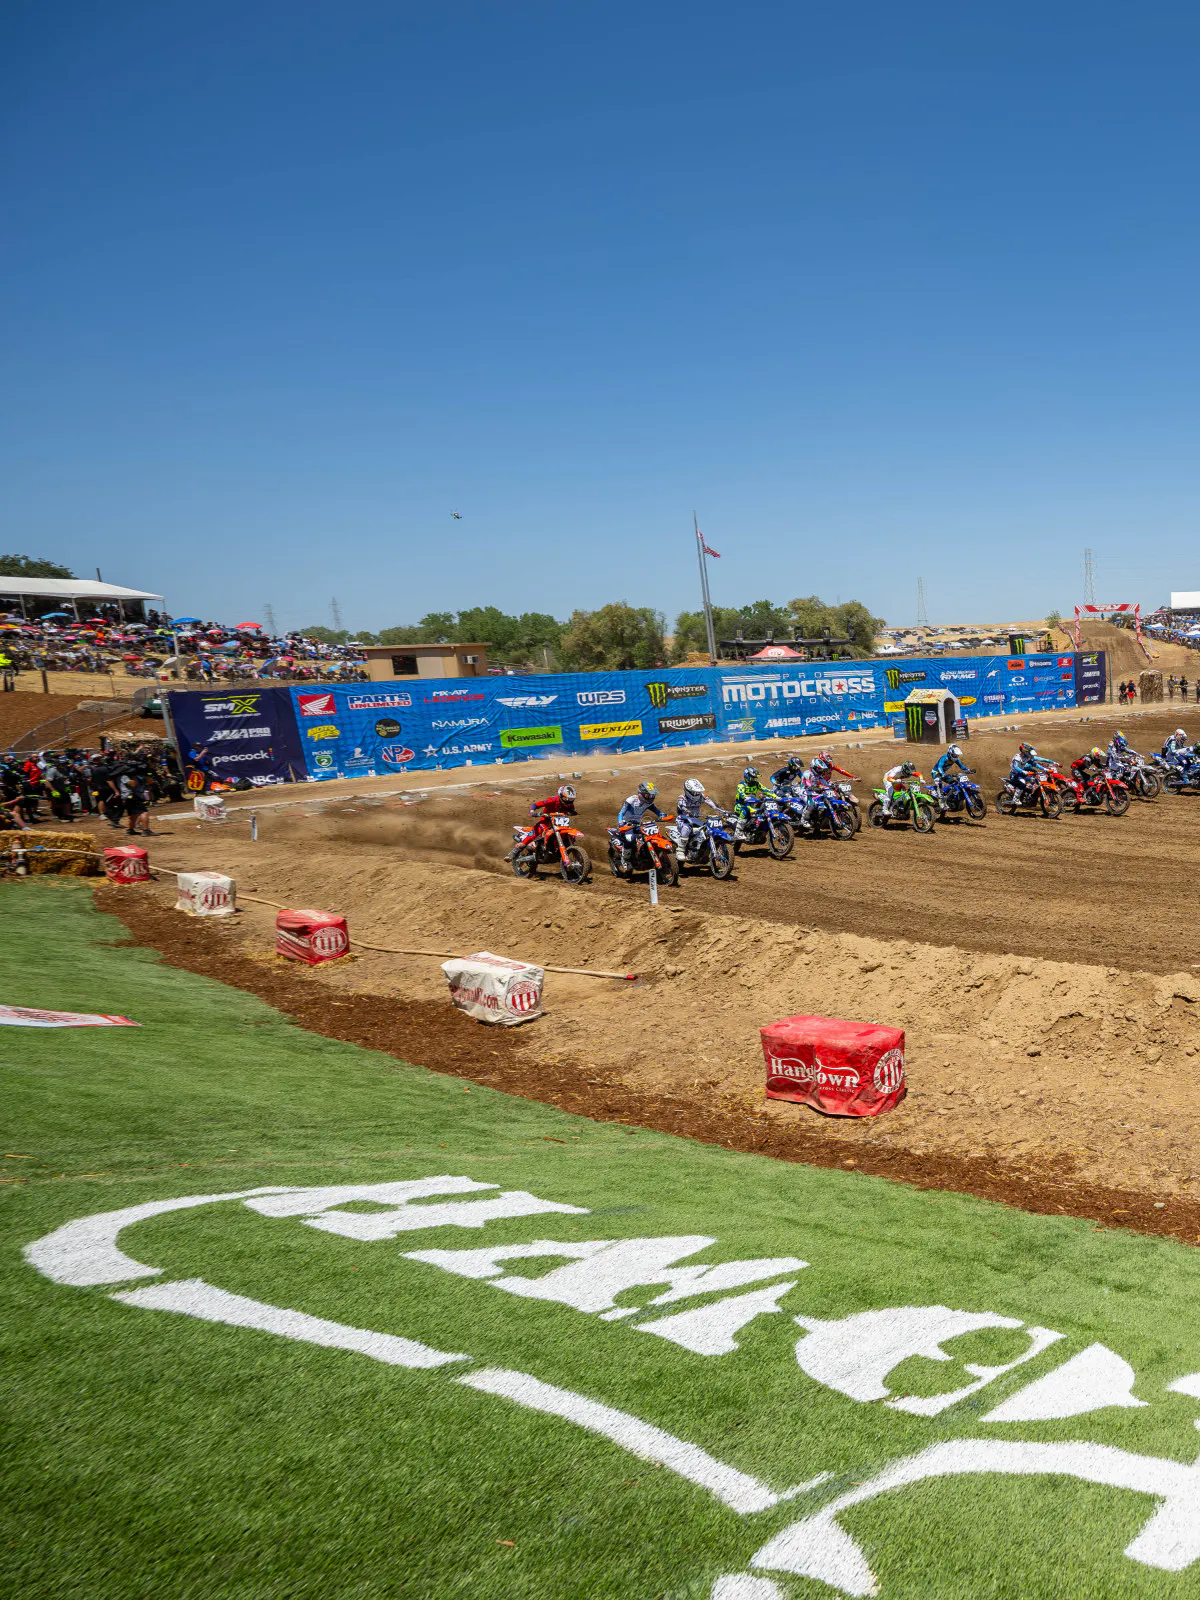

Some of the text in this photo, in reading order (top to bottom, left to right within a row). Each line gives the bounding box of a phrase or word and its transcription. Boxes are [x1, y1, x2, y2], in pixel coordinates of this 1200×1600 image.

[782, 671, 822, 679] PRO
[667, 685, 706, 694] MONSTER
[721, 676, 876, 703] MOTOCROSS
[348, 692, 411, 703] PARTS
[578, 691, 625, 705] WPS
[724, 694, 877, 711] CHAMPIONSHIP
[203, 698, 258, 715] SMX
[349, 700, 412, 709] UNLIMITED
[806, 713, 842, 727] peacock
[861, 710, 879, 720] NBC
[432, 717, 490, 729] NAMURA
[592, 723, 640, 734] DUNLOP
[660, 717, 703, 730] TRIUMPH
[507, 732, 556, 743] Kawasaki
[381, 744, 404, 763] VP
[442, 743, 493, 755] U.S. ARMY
[212, 750, 271, 767] peacock
[554, 816, 571, 827] 142
[709, 820, 723, 828] 784
